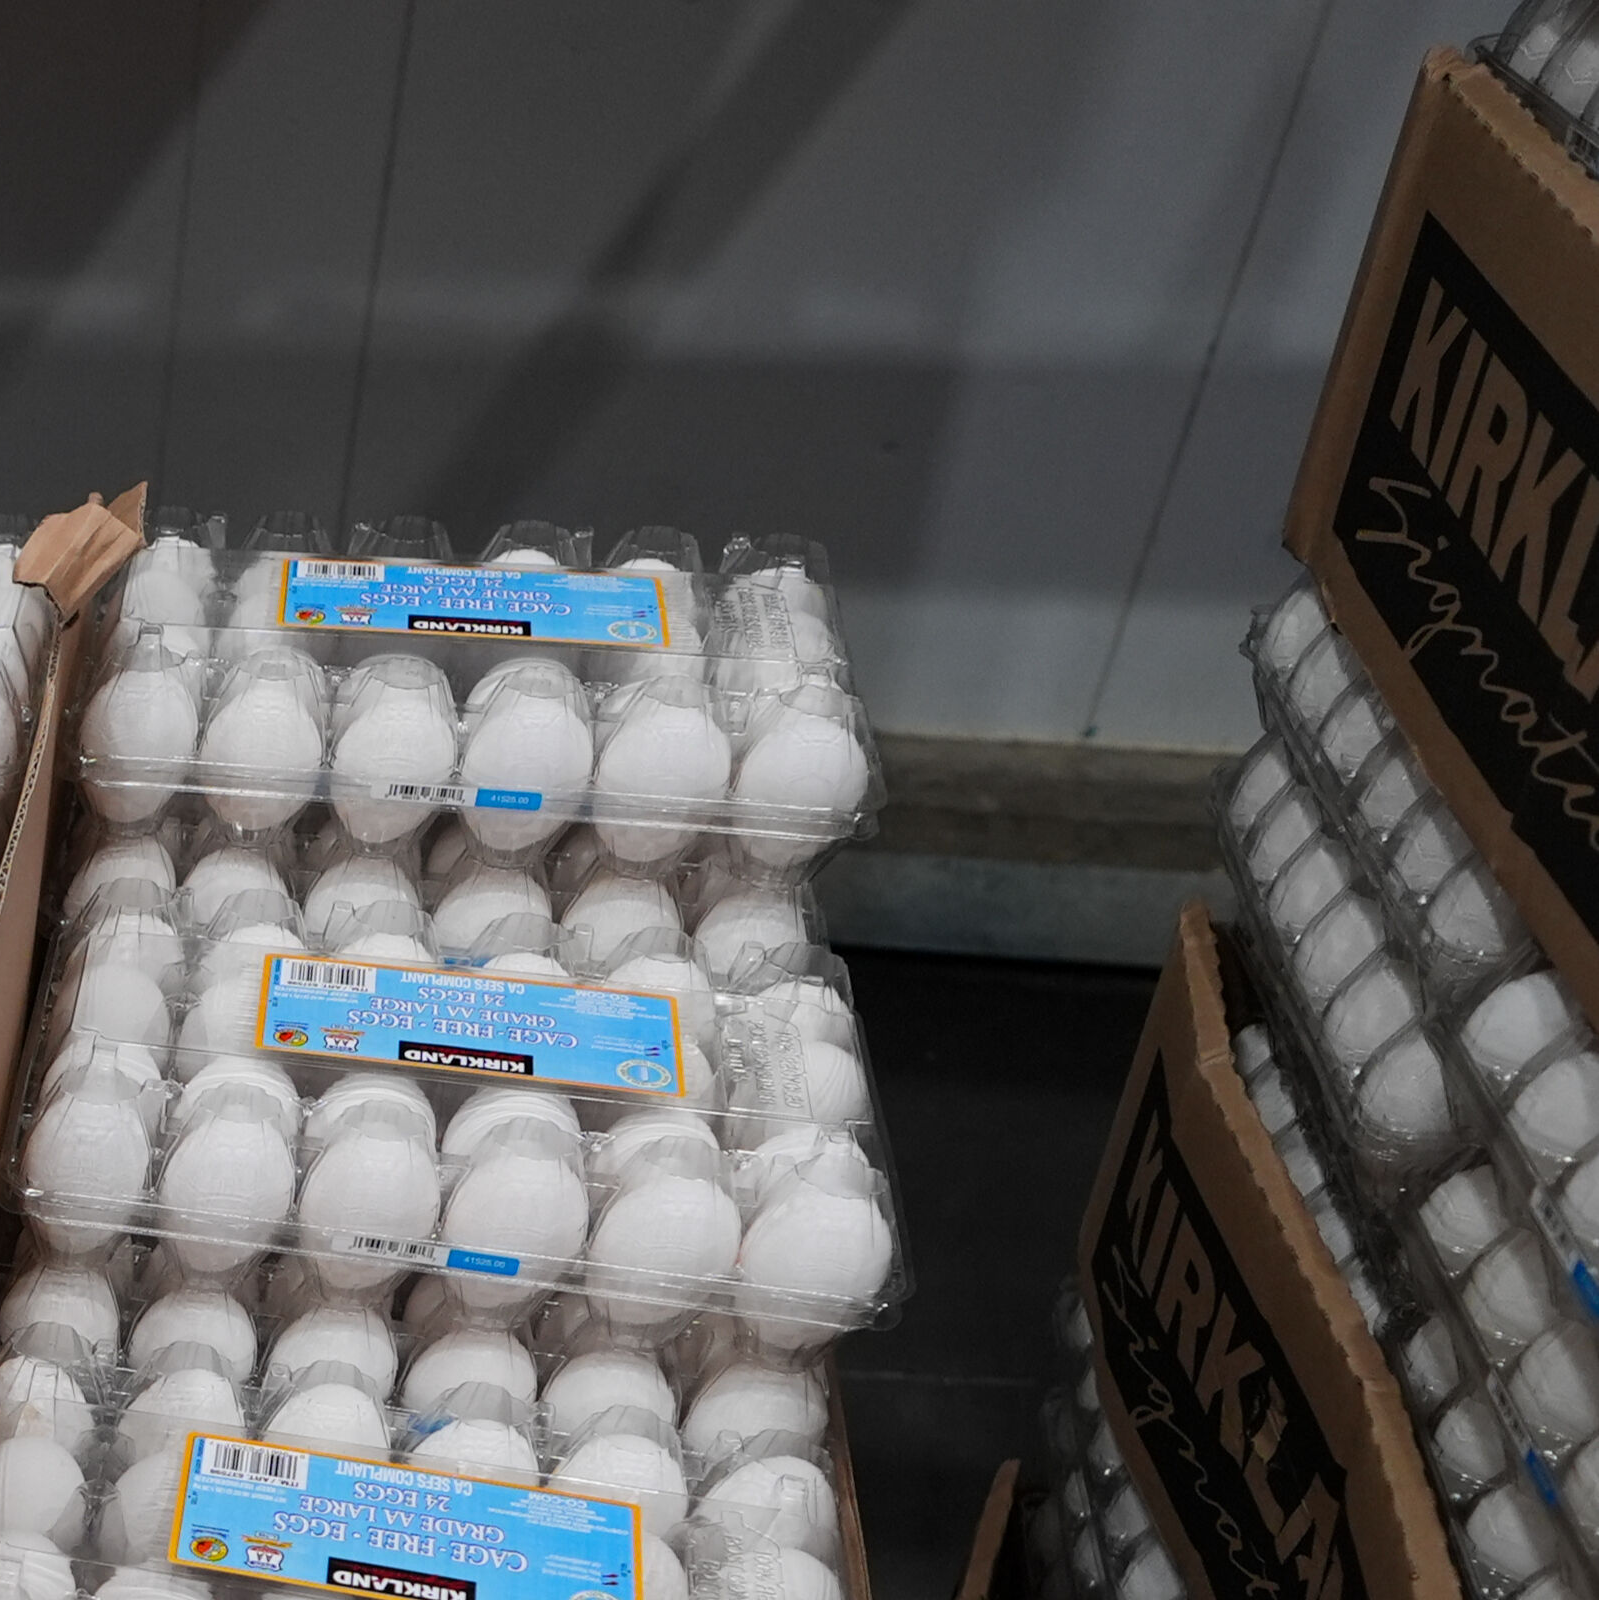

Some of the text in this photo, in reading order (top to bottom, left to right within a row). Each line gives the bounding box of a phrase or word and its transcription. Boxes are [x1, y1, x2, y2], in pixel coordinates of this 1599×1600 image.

[417, 986, 507, 1008] 24 EGGS
[345, 1009, 414, 1031] EGGS
[368, 996, 557, 1029] GRADE AA LARGE
[403, 1049, 526, 1073] KIRKLAND
[333, 1458, 416, 1487] COMPLIANT
[352, 1481, 452, 1514] 24 EGGS
[452, 1478, 475, 1497] CA
[298, 1494, 377, 1524] LARGE
[381, 1508, 416, 1529] AA
[271, 1511, 347, 1543] EGGS
[418, 1514, 505, 1545] GRADE
